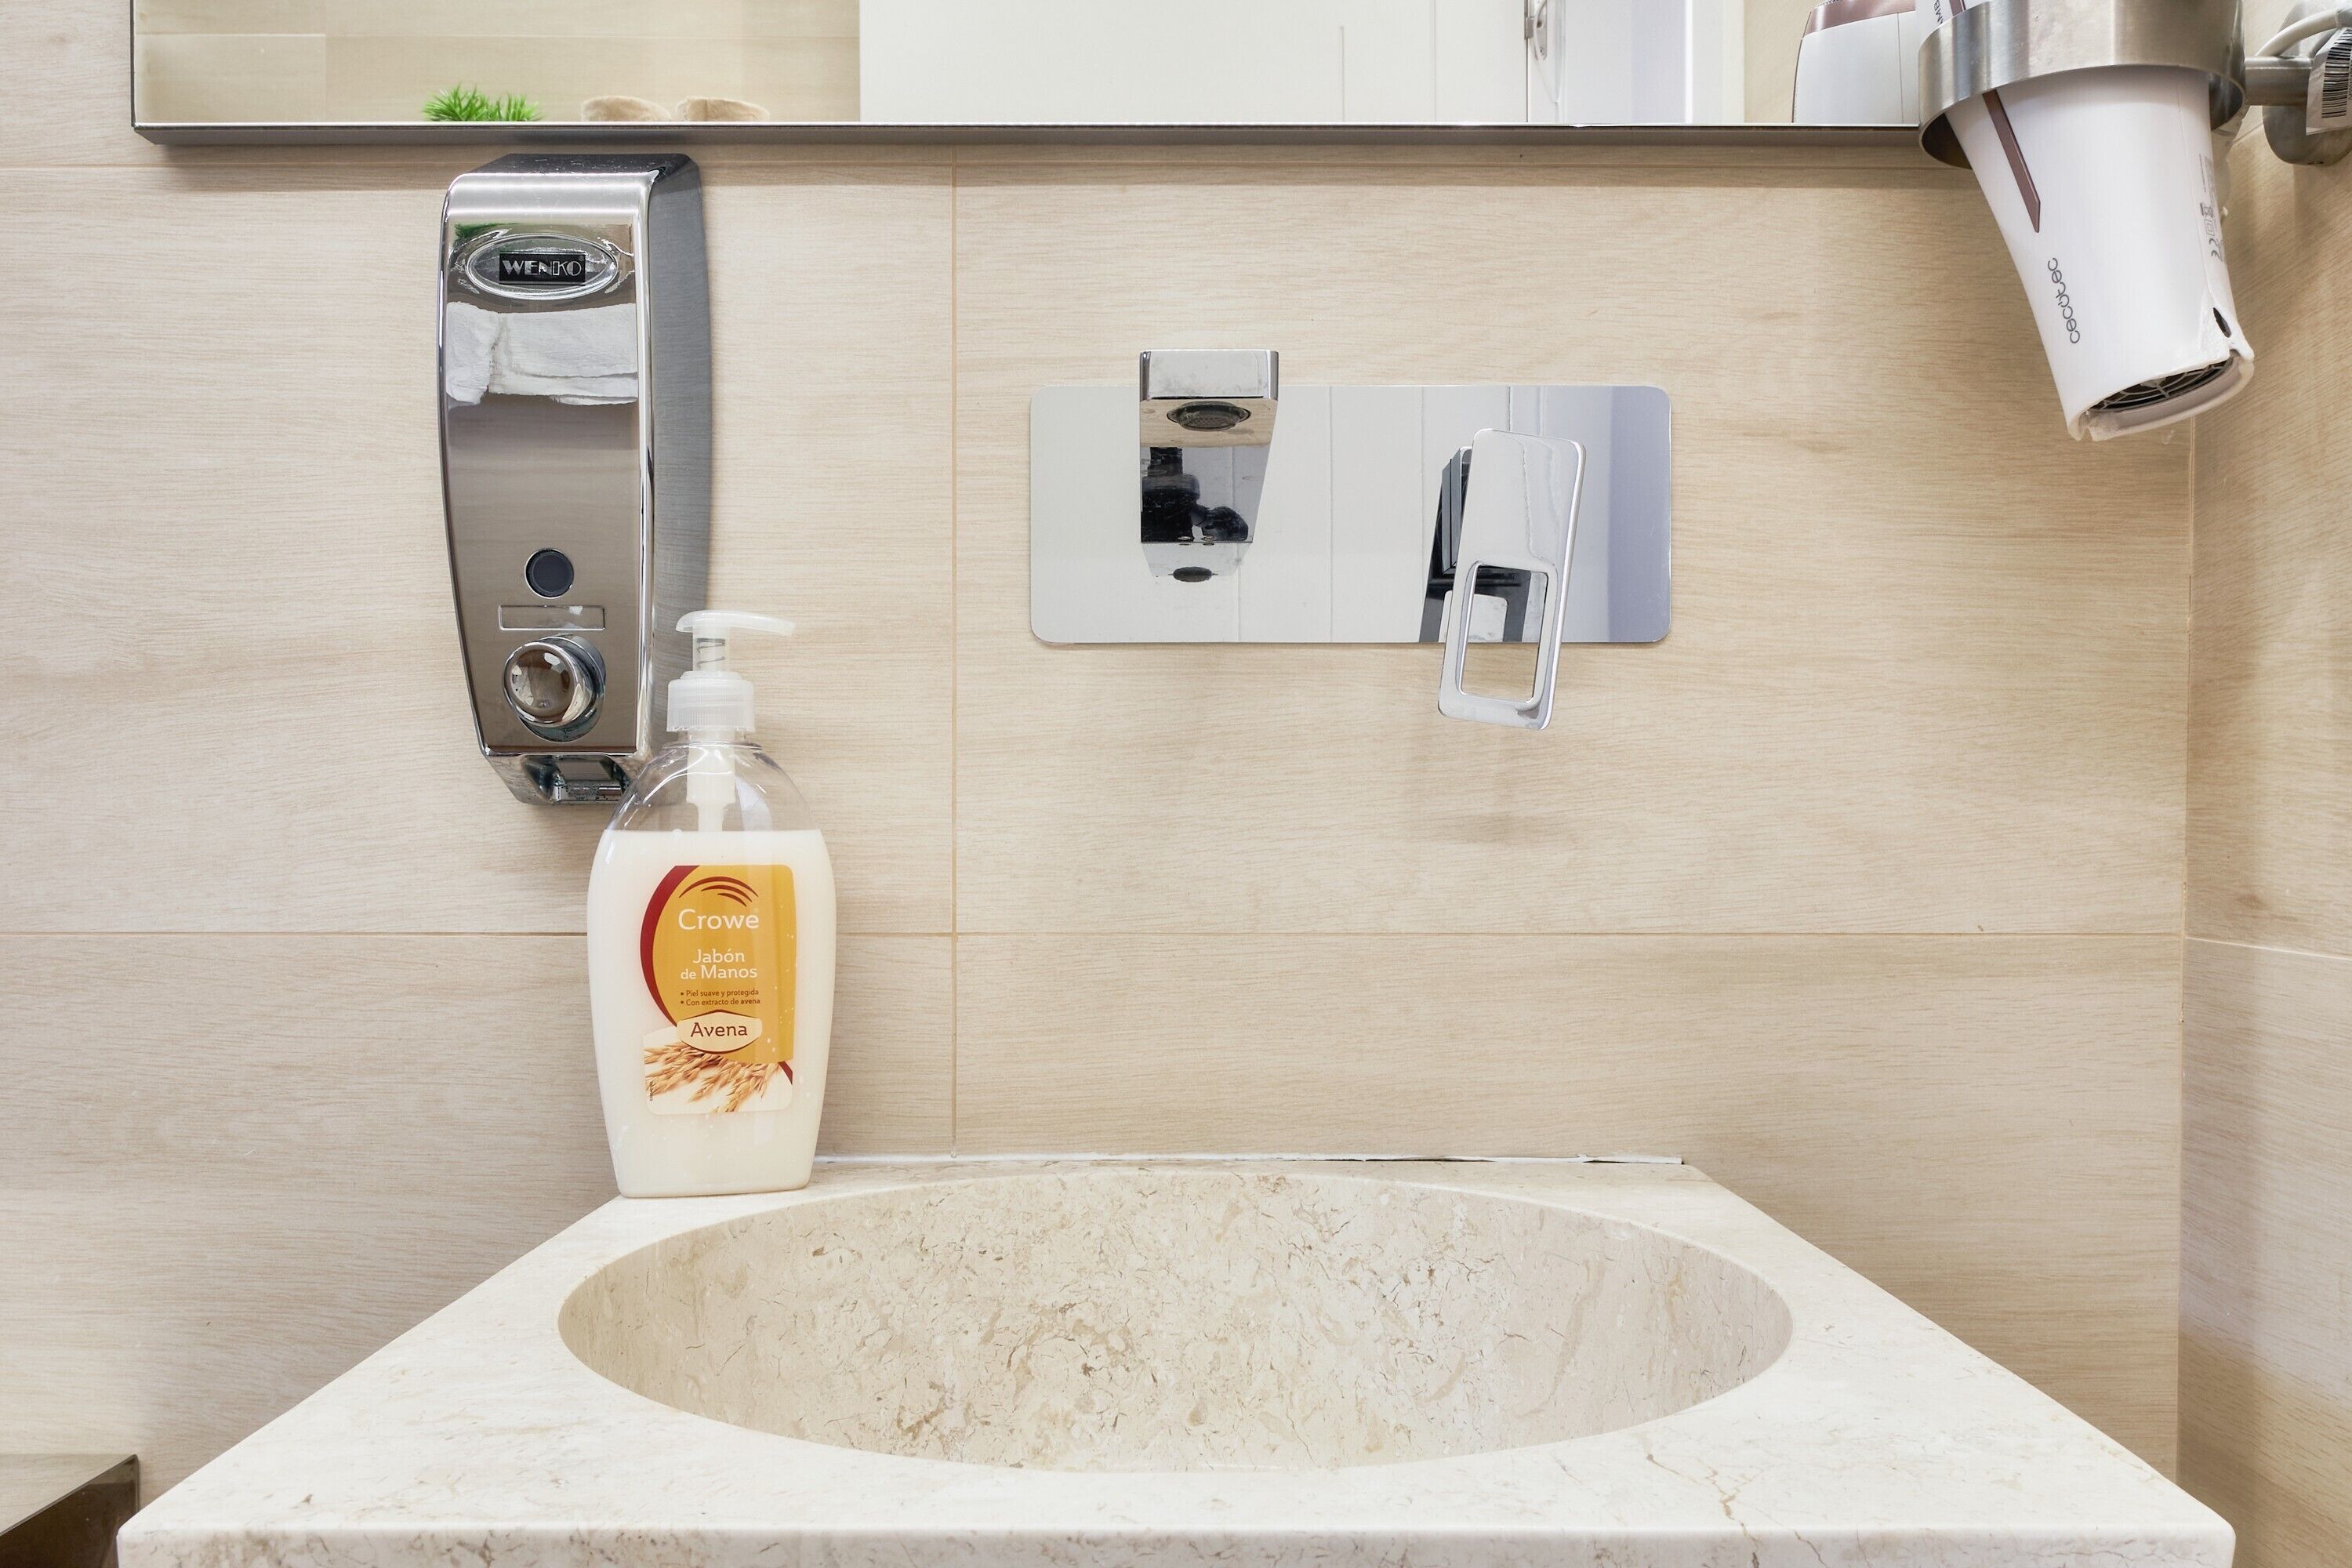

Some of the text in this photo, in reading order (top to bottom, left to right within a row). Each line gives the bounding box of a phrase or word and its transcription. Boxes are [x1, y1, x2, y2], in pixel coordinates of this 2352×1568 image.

[502, 260, 582, 276] WENKO
[2047, 257, 2081, 343] cecotec
[678, 908, 760, 930] Crowe
[692, 948, 746, 964] Jabón
[681, 964, 758, 979] de Manos
[726, 989, 759, 997] protegida
[690, 1022, 748, 1037] Avena
